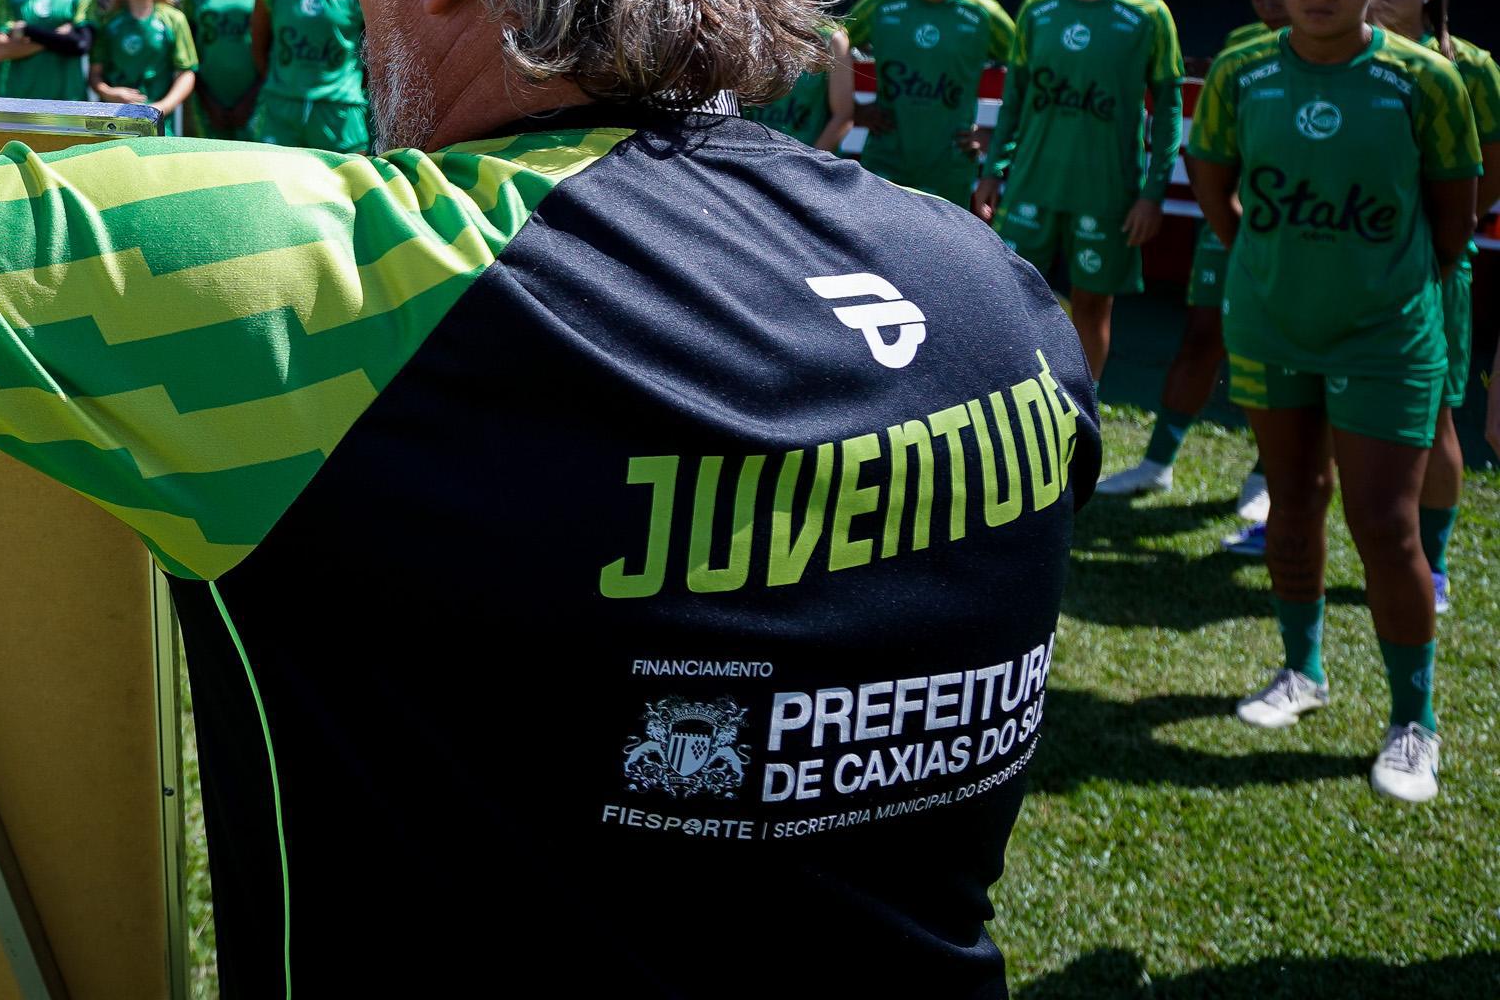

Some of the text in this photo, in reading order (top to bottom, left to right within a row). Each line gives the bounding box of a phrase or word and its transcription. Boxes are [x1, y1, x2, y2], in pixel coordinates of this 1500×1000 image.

[881, 60, 964, 109] Stake
[1032, 67, 1116, 122] Stake
[1250, 166, 1398, 243] Stake
[599, 348, 1079, 599] JUVENTUDE
[631, 659, 774, 678] FINANCIAMENTO
[767, 631, 1056, 752] PREFEITURA
[762, 758, 825, 802] DE
[833, 735, 973, 794] CAXIAS
[976, 718, 1017, 765] DO
[601, 804, 755, 840] FIESPORTE
[773, 808, 871, 839] SECRETARIA
[874, 790, 953, 820] MUNICIPAL
[955, 783, 976, 802] DO
